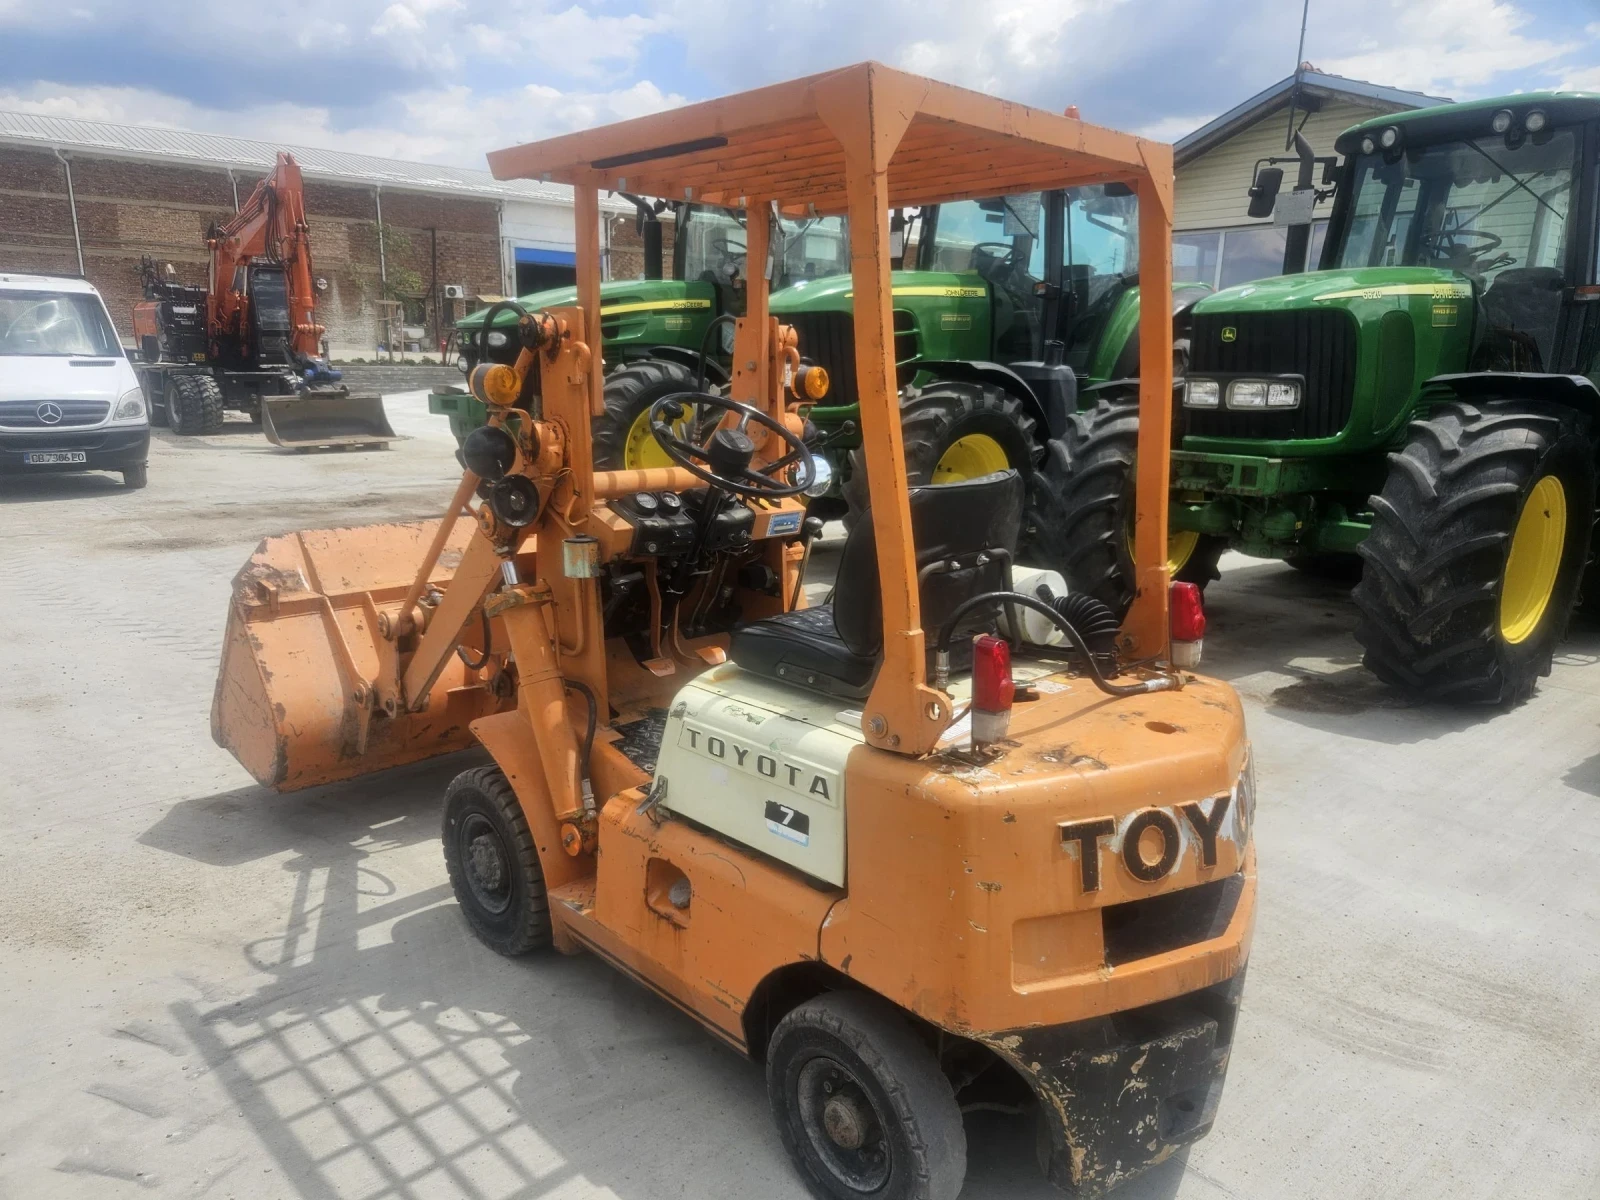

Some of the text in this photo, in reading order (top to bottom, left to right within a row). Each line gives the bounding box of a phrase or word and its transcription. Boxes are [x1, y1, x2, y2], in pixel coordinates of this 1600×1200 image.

[944, 288, 978, 298] JOHN DEERE
[686, 727, 830, 801] TOYOTA
[780, 806, 794, 825] 7
